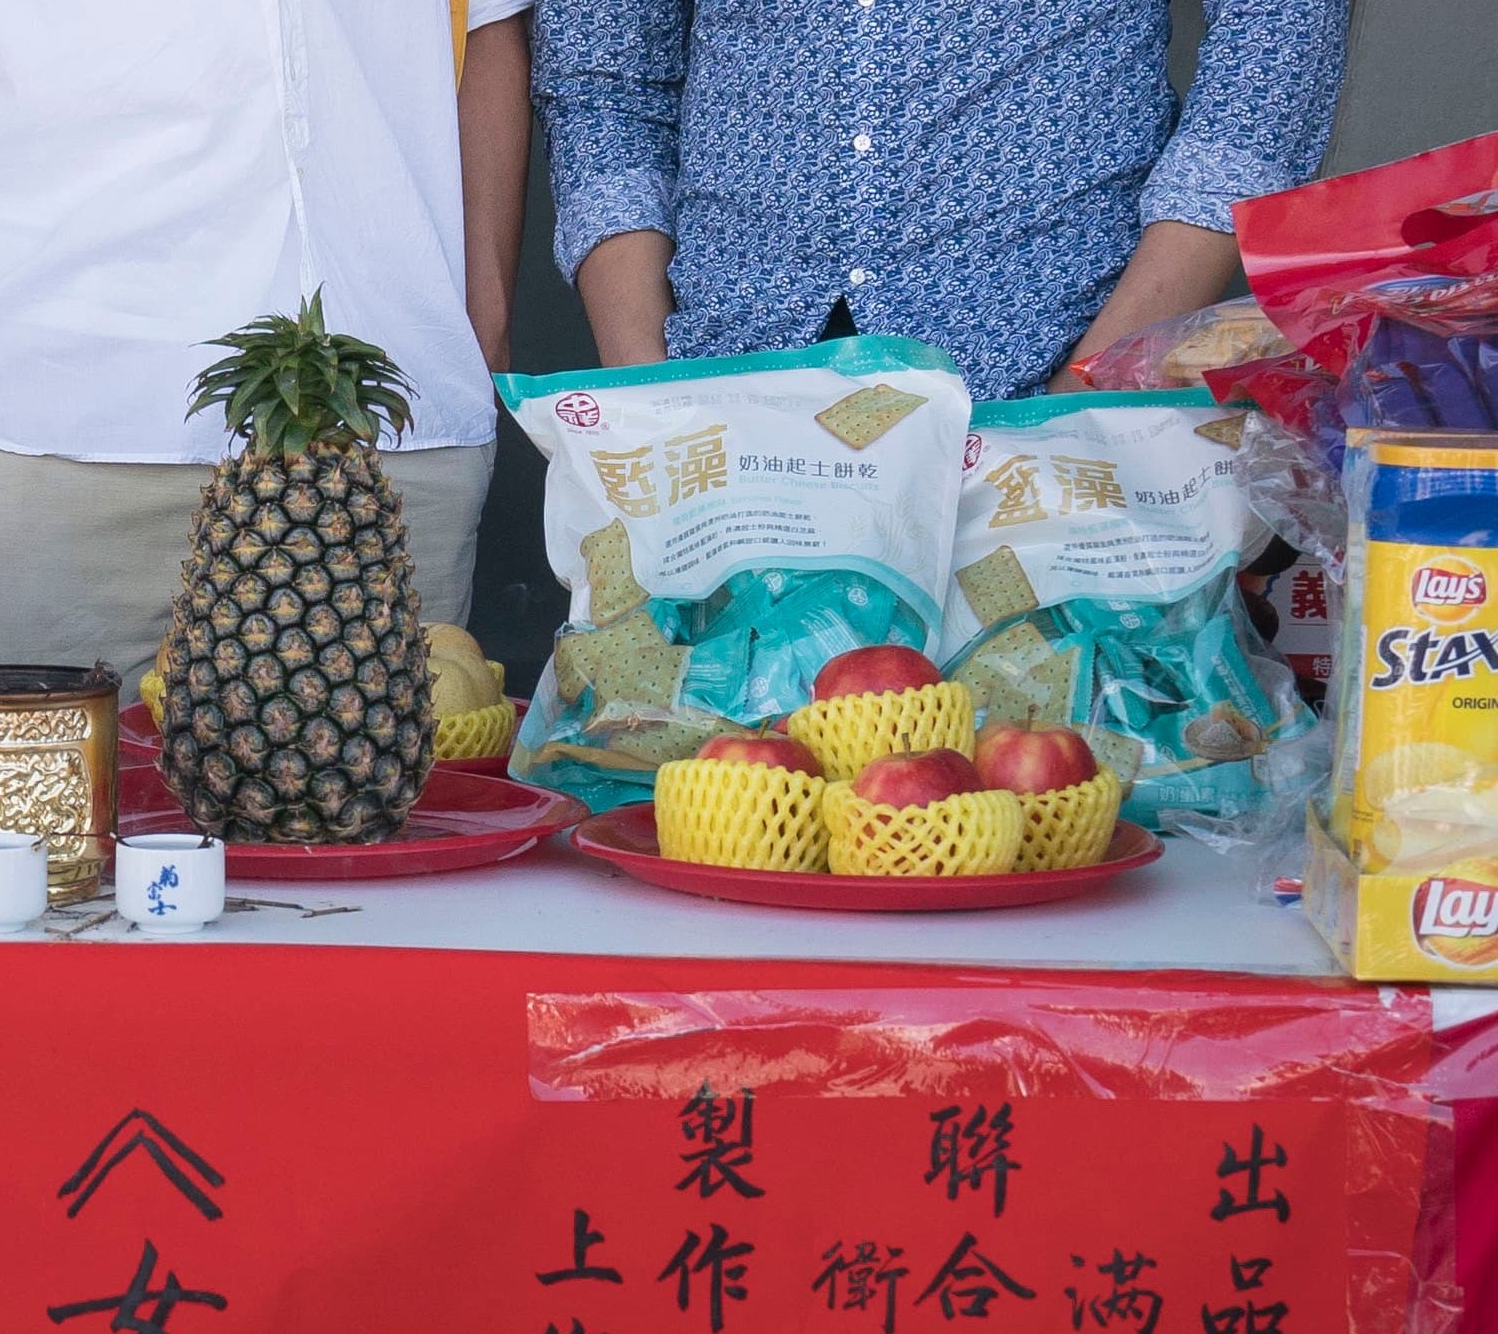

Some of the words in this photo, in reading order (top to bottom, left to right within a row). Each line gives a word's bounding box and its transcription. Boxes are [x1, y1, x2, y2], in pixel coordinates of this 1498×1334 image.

[738, 454, 879, 479] 奶油起士餅乾
[1414, 569, 1484, 605] Lay's
